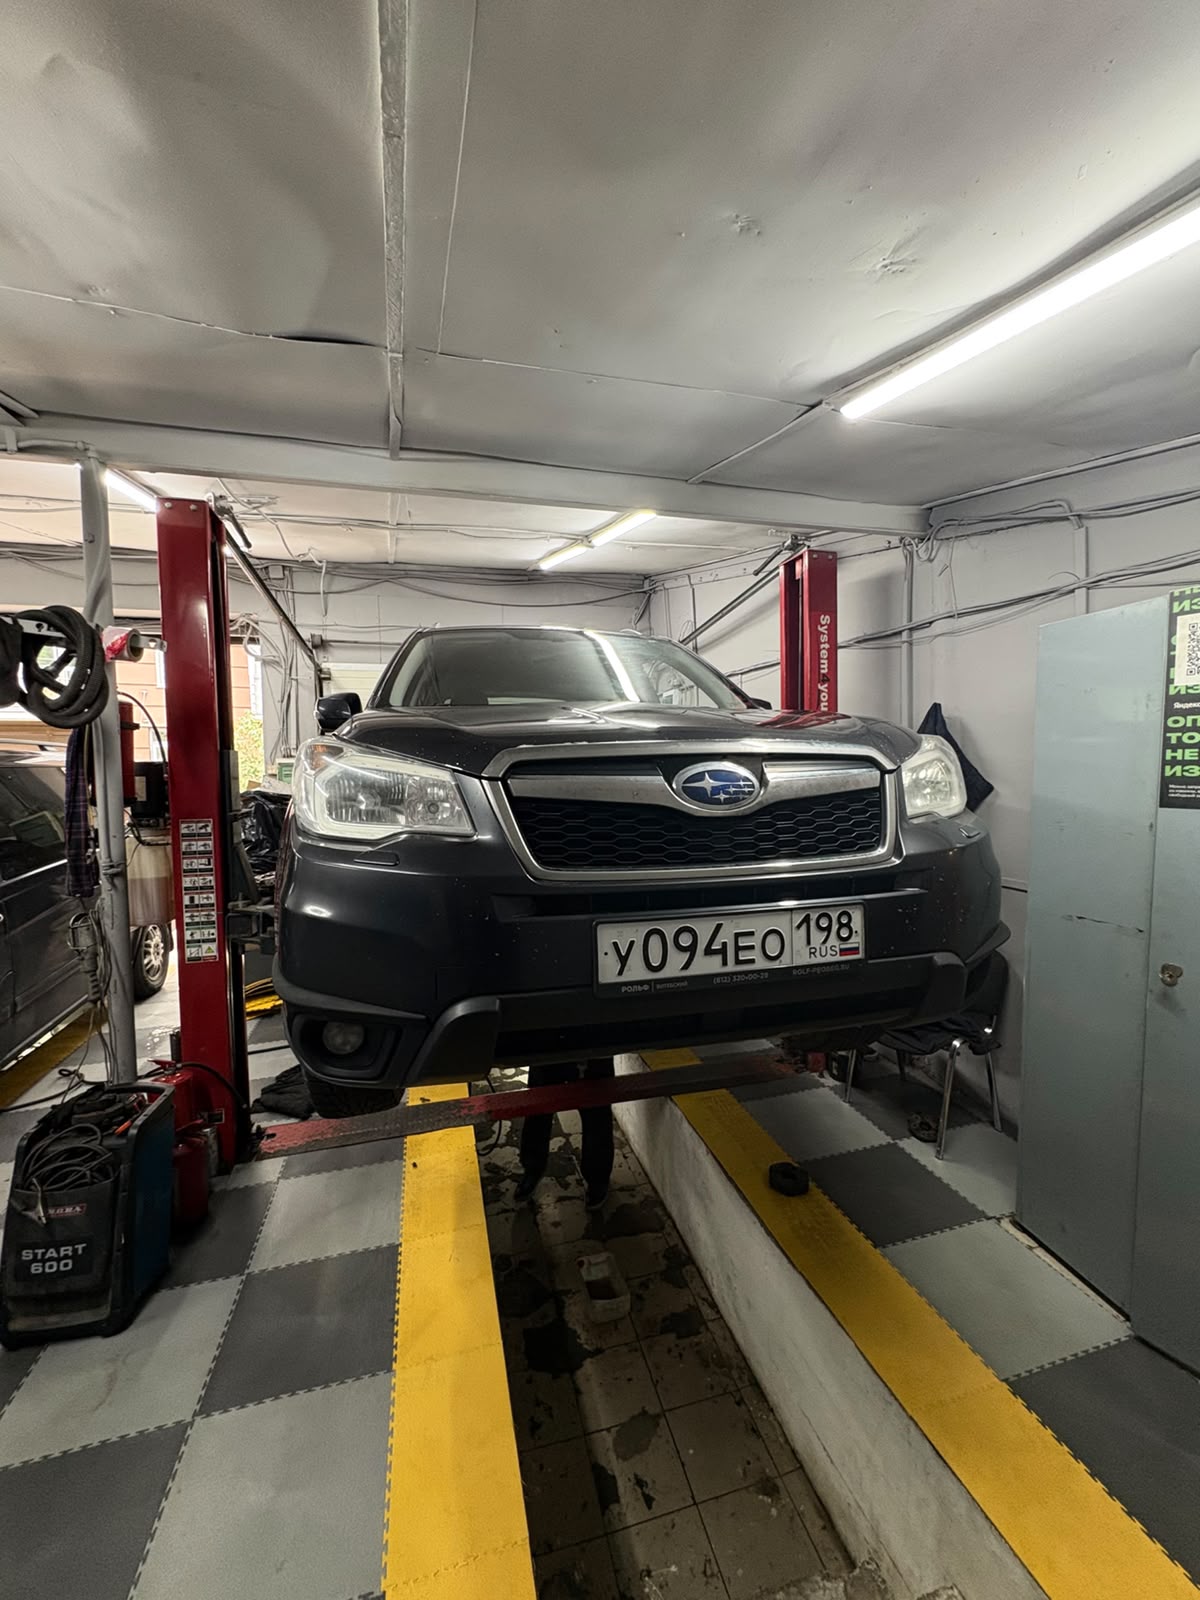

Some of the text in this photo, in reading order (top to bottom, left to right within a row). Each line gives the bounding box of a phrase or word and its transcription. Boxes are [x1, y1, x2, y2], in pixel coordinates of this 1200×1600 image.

[818, 614, 831, 711] System4you
[1165, 748, 1199, 761] НЕ
[795, 910, 854, 946] 198
[611, 922, 786, 976] У094ЕО
[809, 944, 838, 959] RUS
[621, 984, 650, 993] РОЛЬФ
[21, 1243, 87, 1261] START
[31, 1259, 73, 1274] 600
